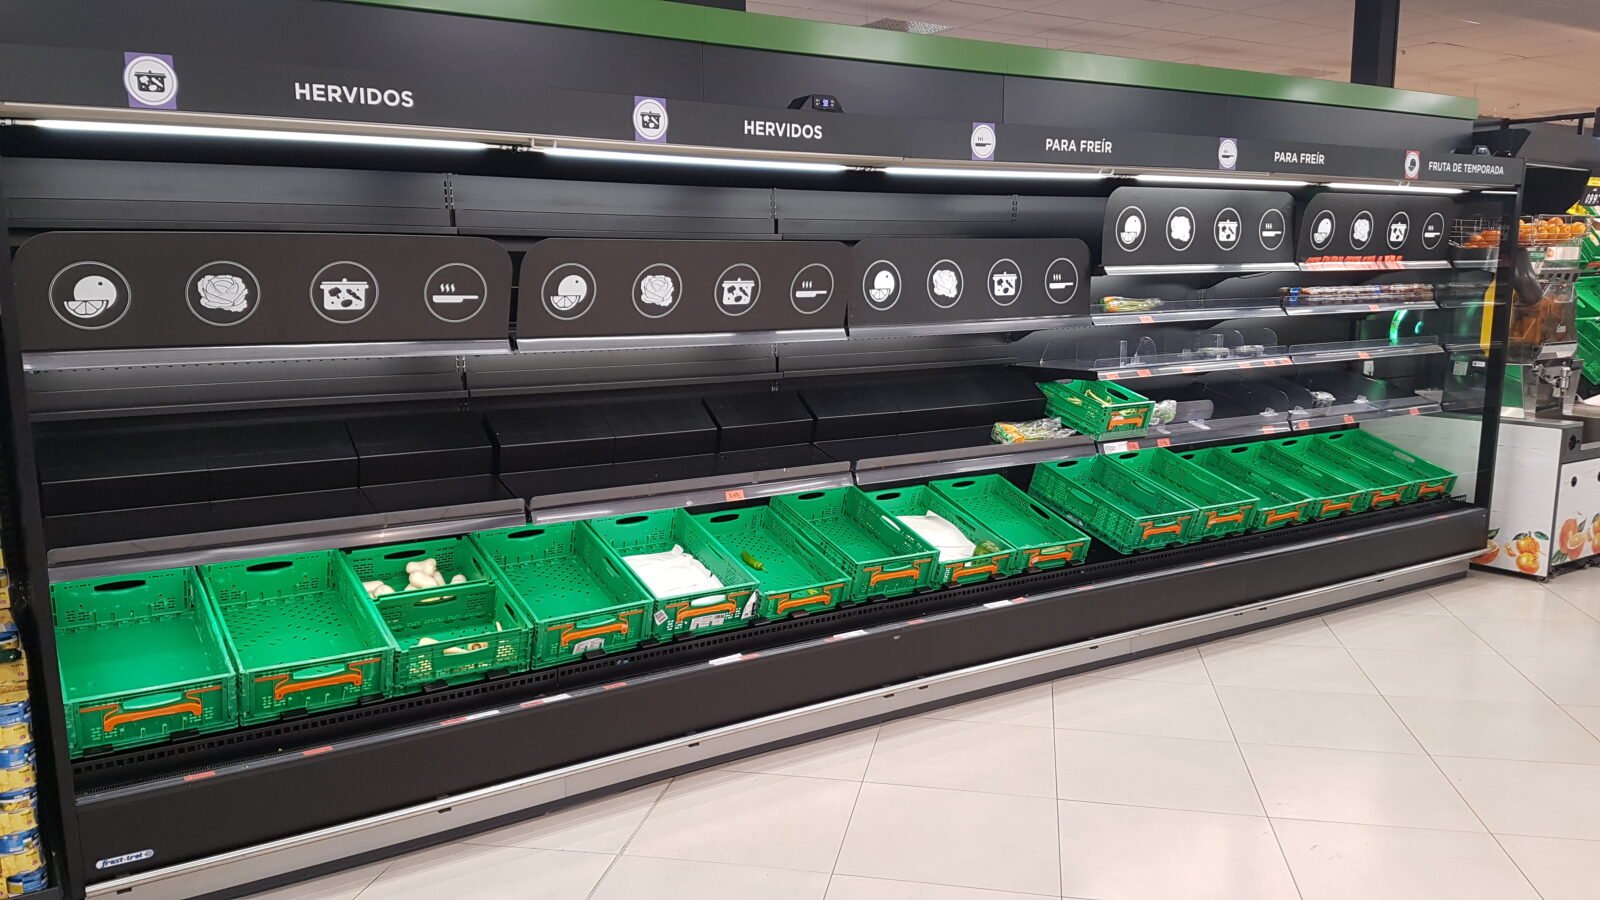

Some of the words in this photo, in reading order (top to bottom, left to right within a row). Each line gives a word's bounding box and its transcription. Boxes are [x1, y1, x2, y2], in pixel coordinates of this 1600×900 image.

[294, 81, 415, 108] HERVIDOS
[743, 119, 824, 140] HERVIDOS
[1045, 138, 1077, 152] PARA
[1079, 137, 1113, 154] FREÍR
[1274, 151, 1298, 164] PARA
[1299, 151, 1325, 165] FREÍR
[1428, 160, 1451, 172] FRUTA
[1452, 162, 1463, 173] DE
[1463, 163, 1505, 176] TEMPORADA
